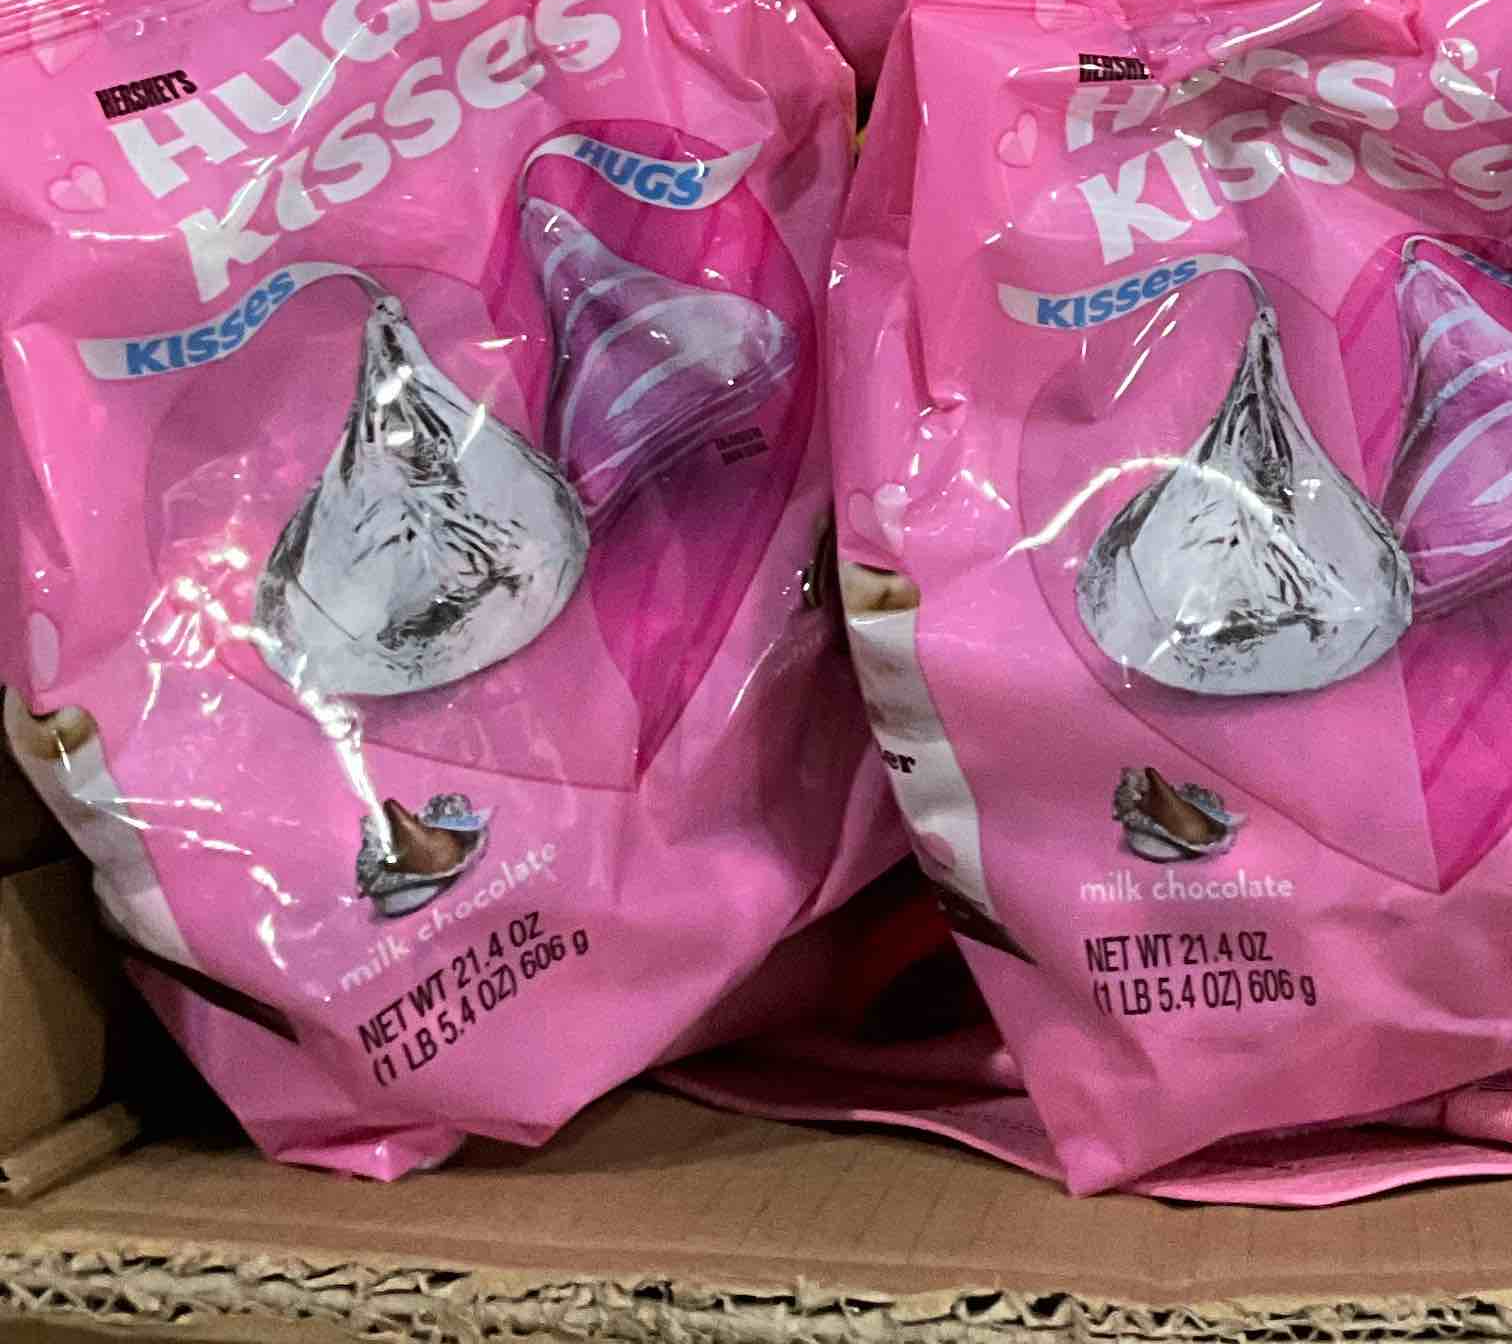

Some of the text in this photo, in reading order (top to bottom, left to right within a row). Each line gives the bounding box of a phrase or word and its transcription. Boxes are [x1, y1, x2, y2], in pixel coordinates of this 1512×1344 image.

[95, 69, 198, 119] HERSHEY'S
[573, 137, 712, 207] HUGS
[1079, 869, 1297, 903] milk chocolate
[341, 842, 557, 992] milk chocolate
[1086, 931, 1273, 974] NET WT 21.4 OZ
[357, 911, 548, 1056] NET WT 21.4 OZ
[374, 929, 590, 1088] (1 LB 5.4 OZ) 606 g
[1093, 968, 1317, 1017] (1 LB 5.4 OZ) 606 g
